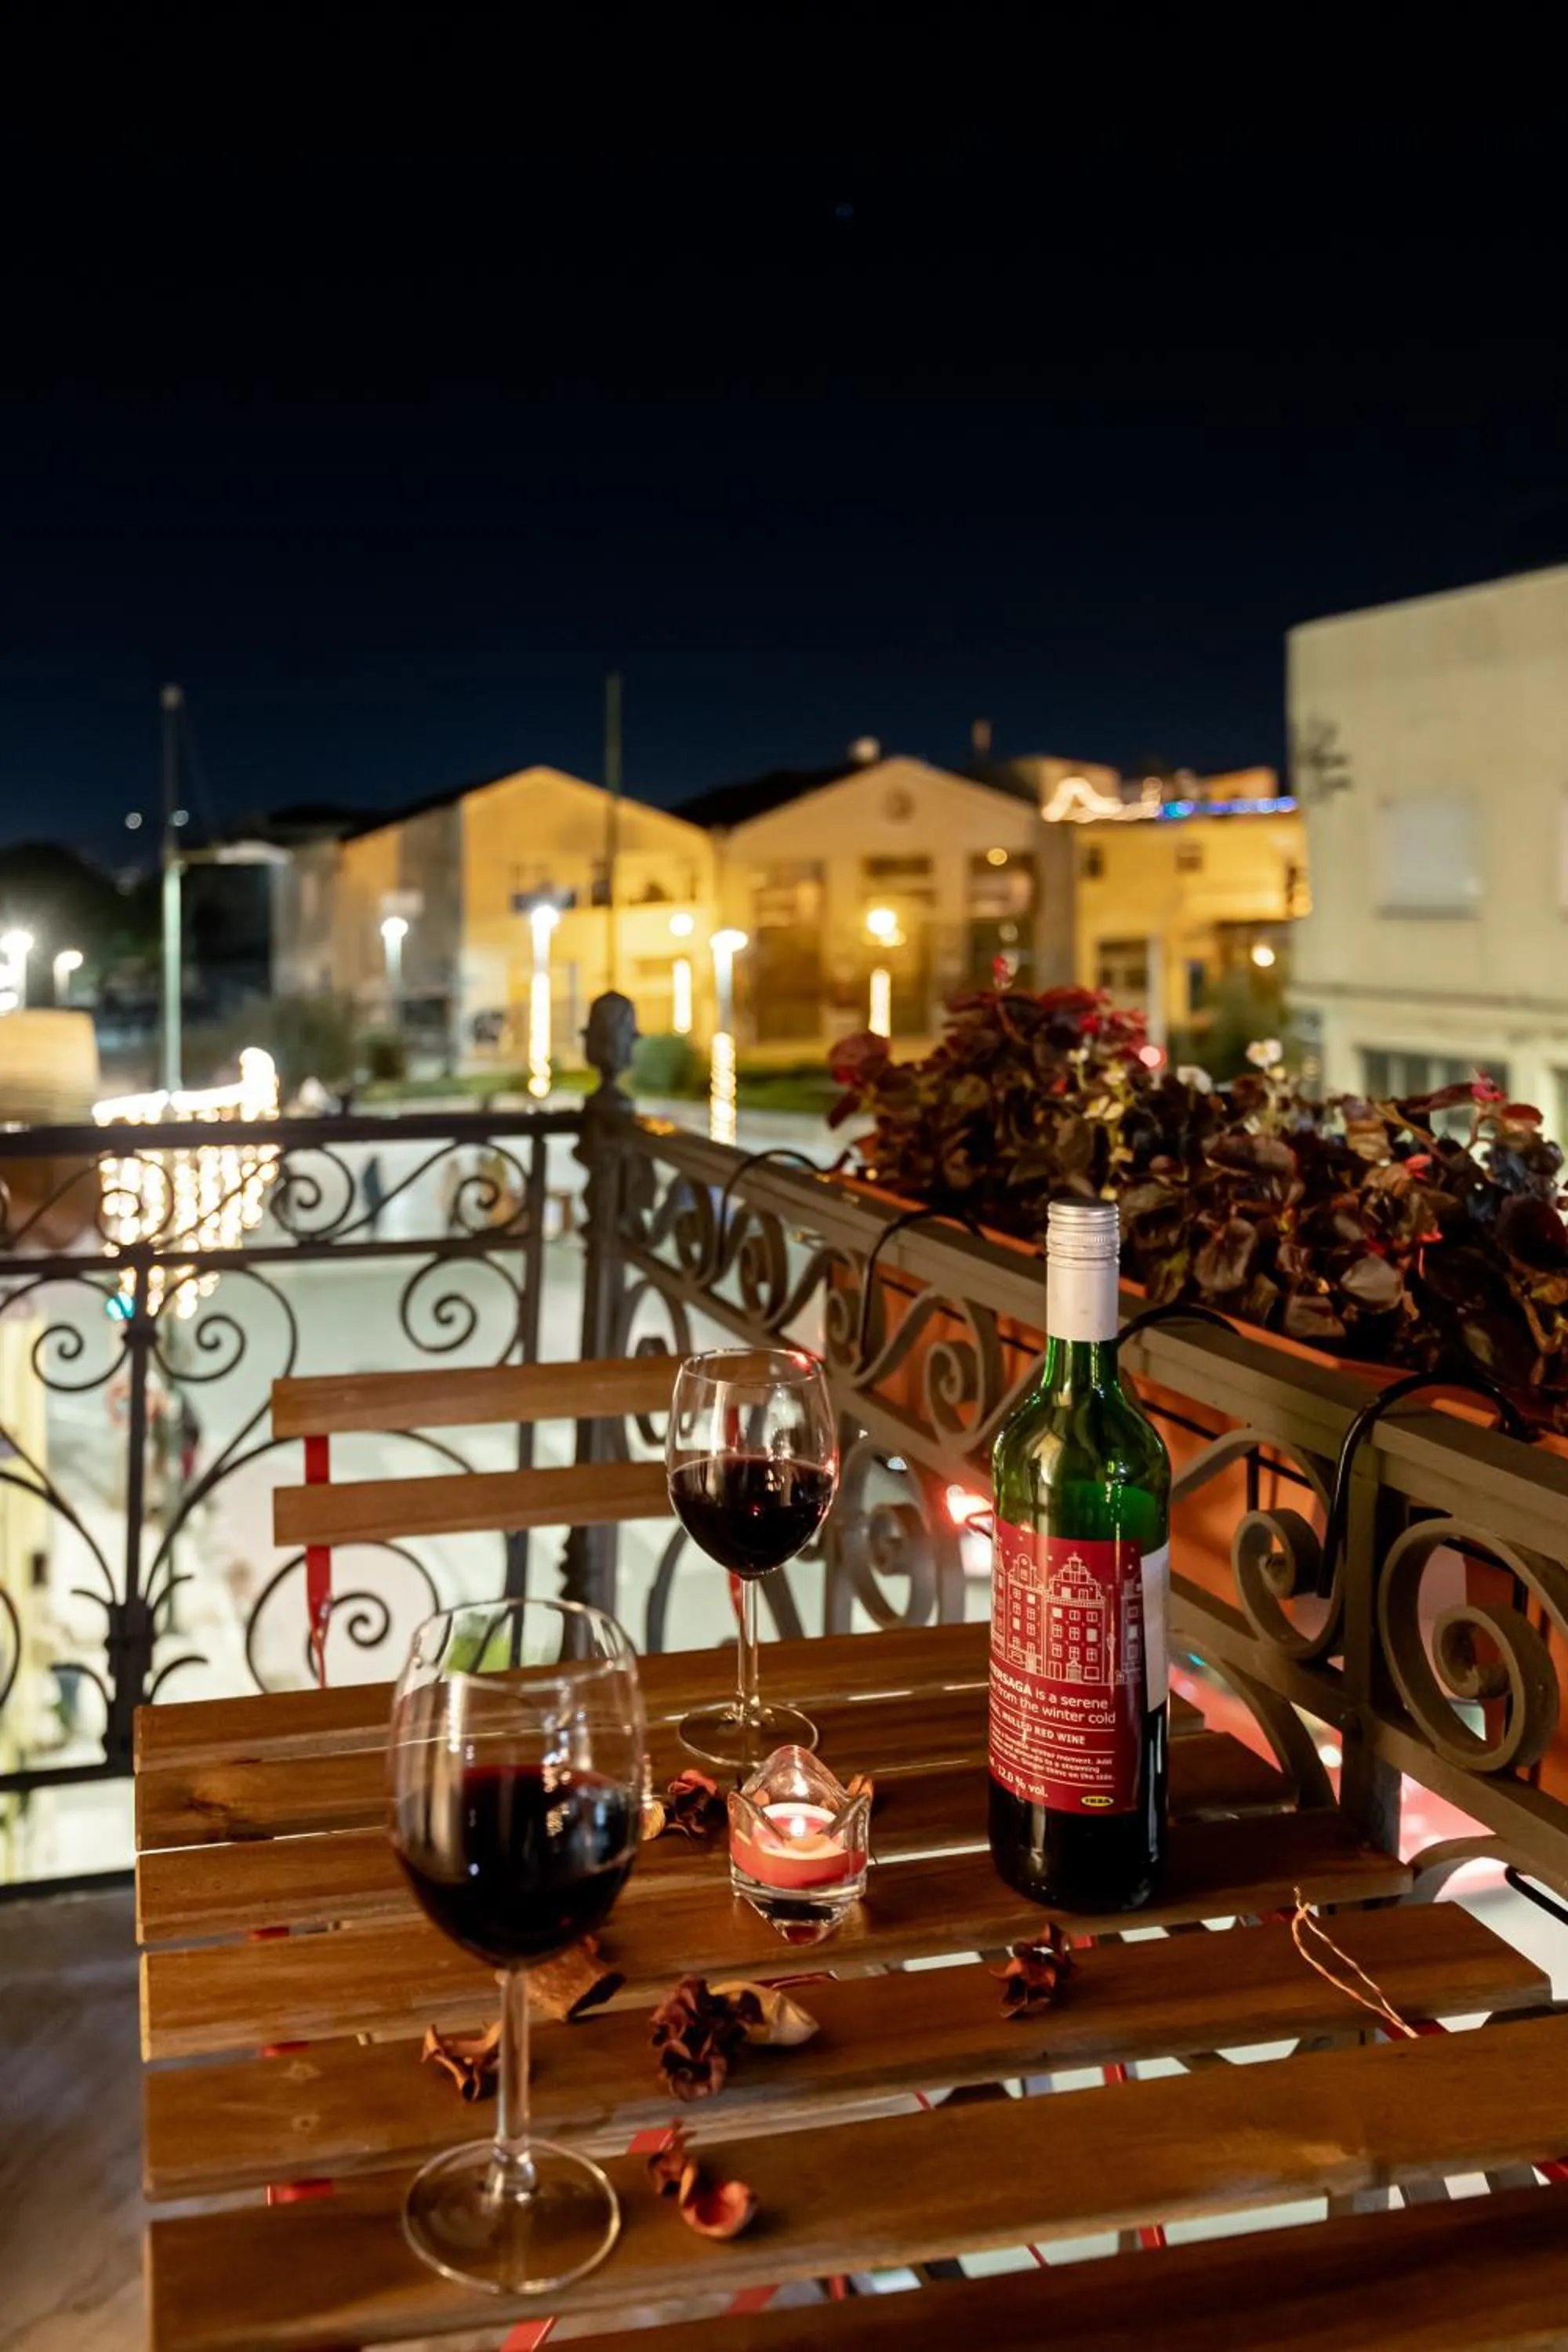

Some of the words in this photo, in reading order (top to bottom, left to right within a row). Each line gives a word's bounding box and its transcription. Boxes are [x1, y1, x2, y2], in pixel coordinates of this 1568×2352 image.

[996, 1683, 1018, 1705] from
[1020, 1697, 1039, 1713] the
[1042, 1705, 1086, 1722] winter
[1088, 1711, 1116, 1725] cold
[1036, 1686, 1046, 1700] is
[1048, 1693, 1057, 1704] a
[1061, 1696, 1108, 1709] serene
[1034, 1726, 1054, 1739] RED
[1056, 1732, 1086, 1745] WINE
[1029, 1784, 1048, 1797] vol.
